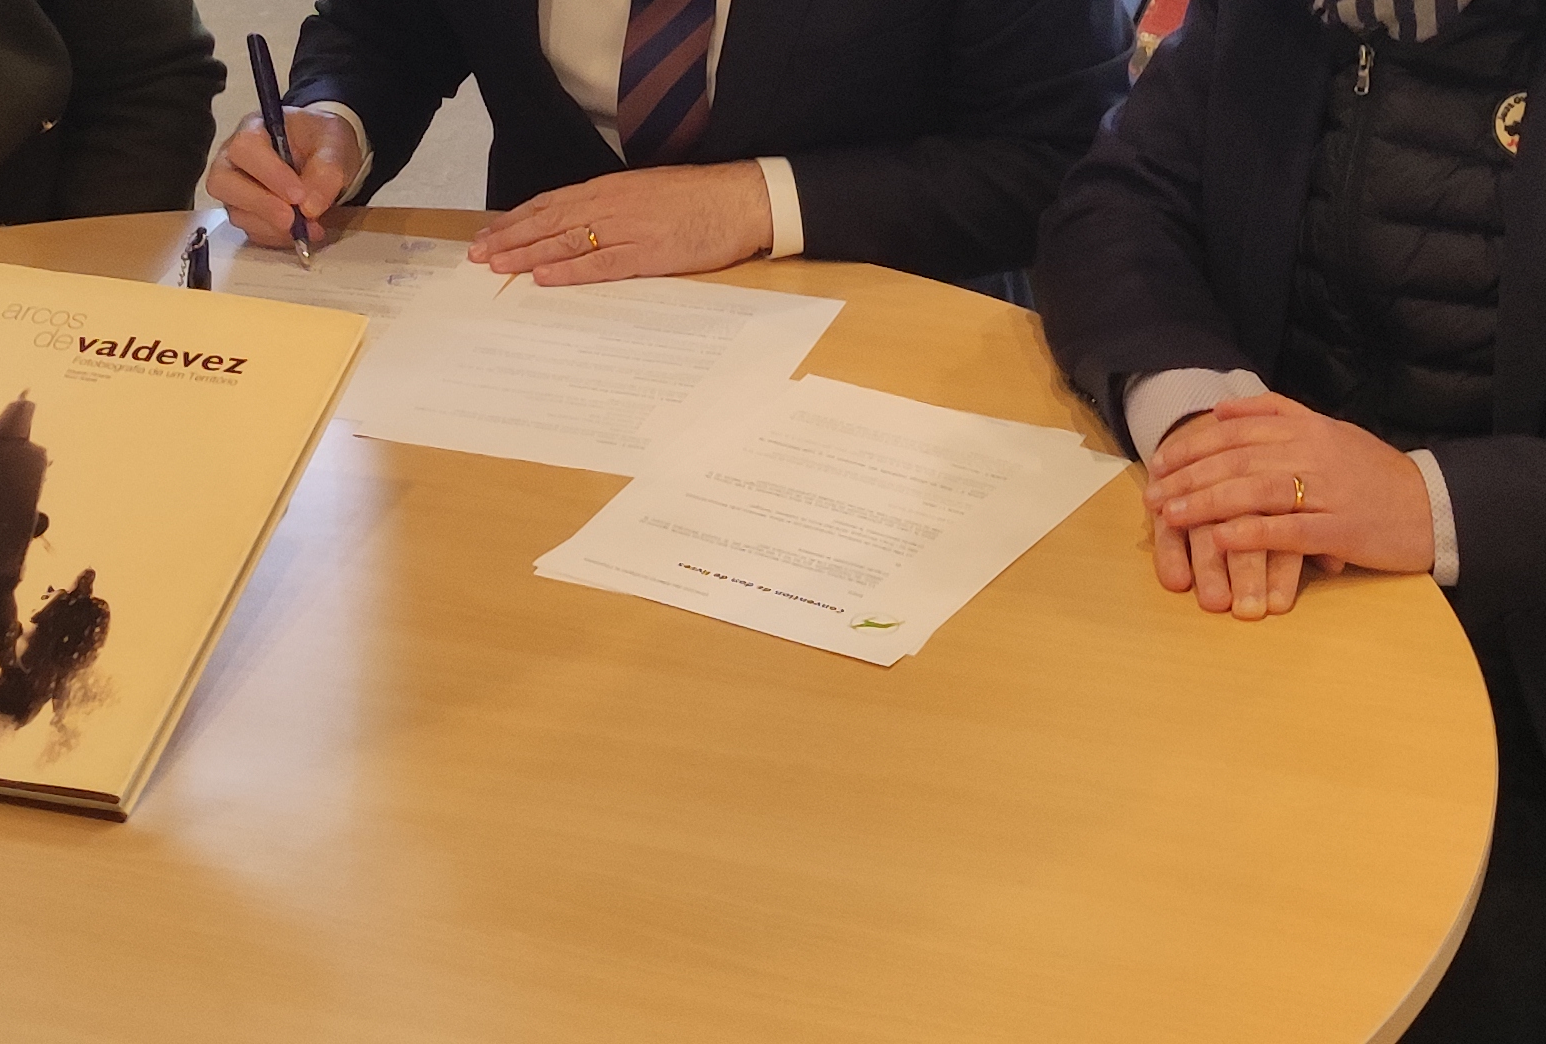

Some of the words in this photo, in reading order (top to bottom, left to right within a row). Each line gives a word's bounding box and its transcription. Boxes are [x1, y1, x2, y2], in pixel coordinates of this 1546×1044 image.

[1, 302, 88, 330] arcos
[32, 329, 75, 352] de
[77, 336, 249, 375] valdevez
[71, 355, 146, 375] Fotobiografia
[165, 369, 185, 380] um
[678, 561, 711, 576] livres
[713, 571, 728, 580] de
[731, 577, 754, 588] don
[756, 584, 772, 593] de
[774, 589, 845, 614] Convention
